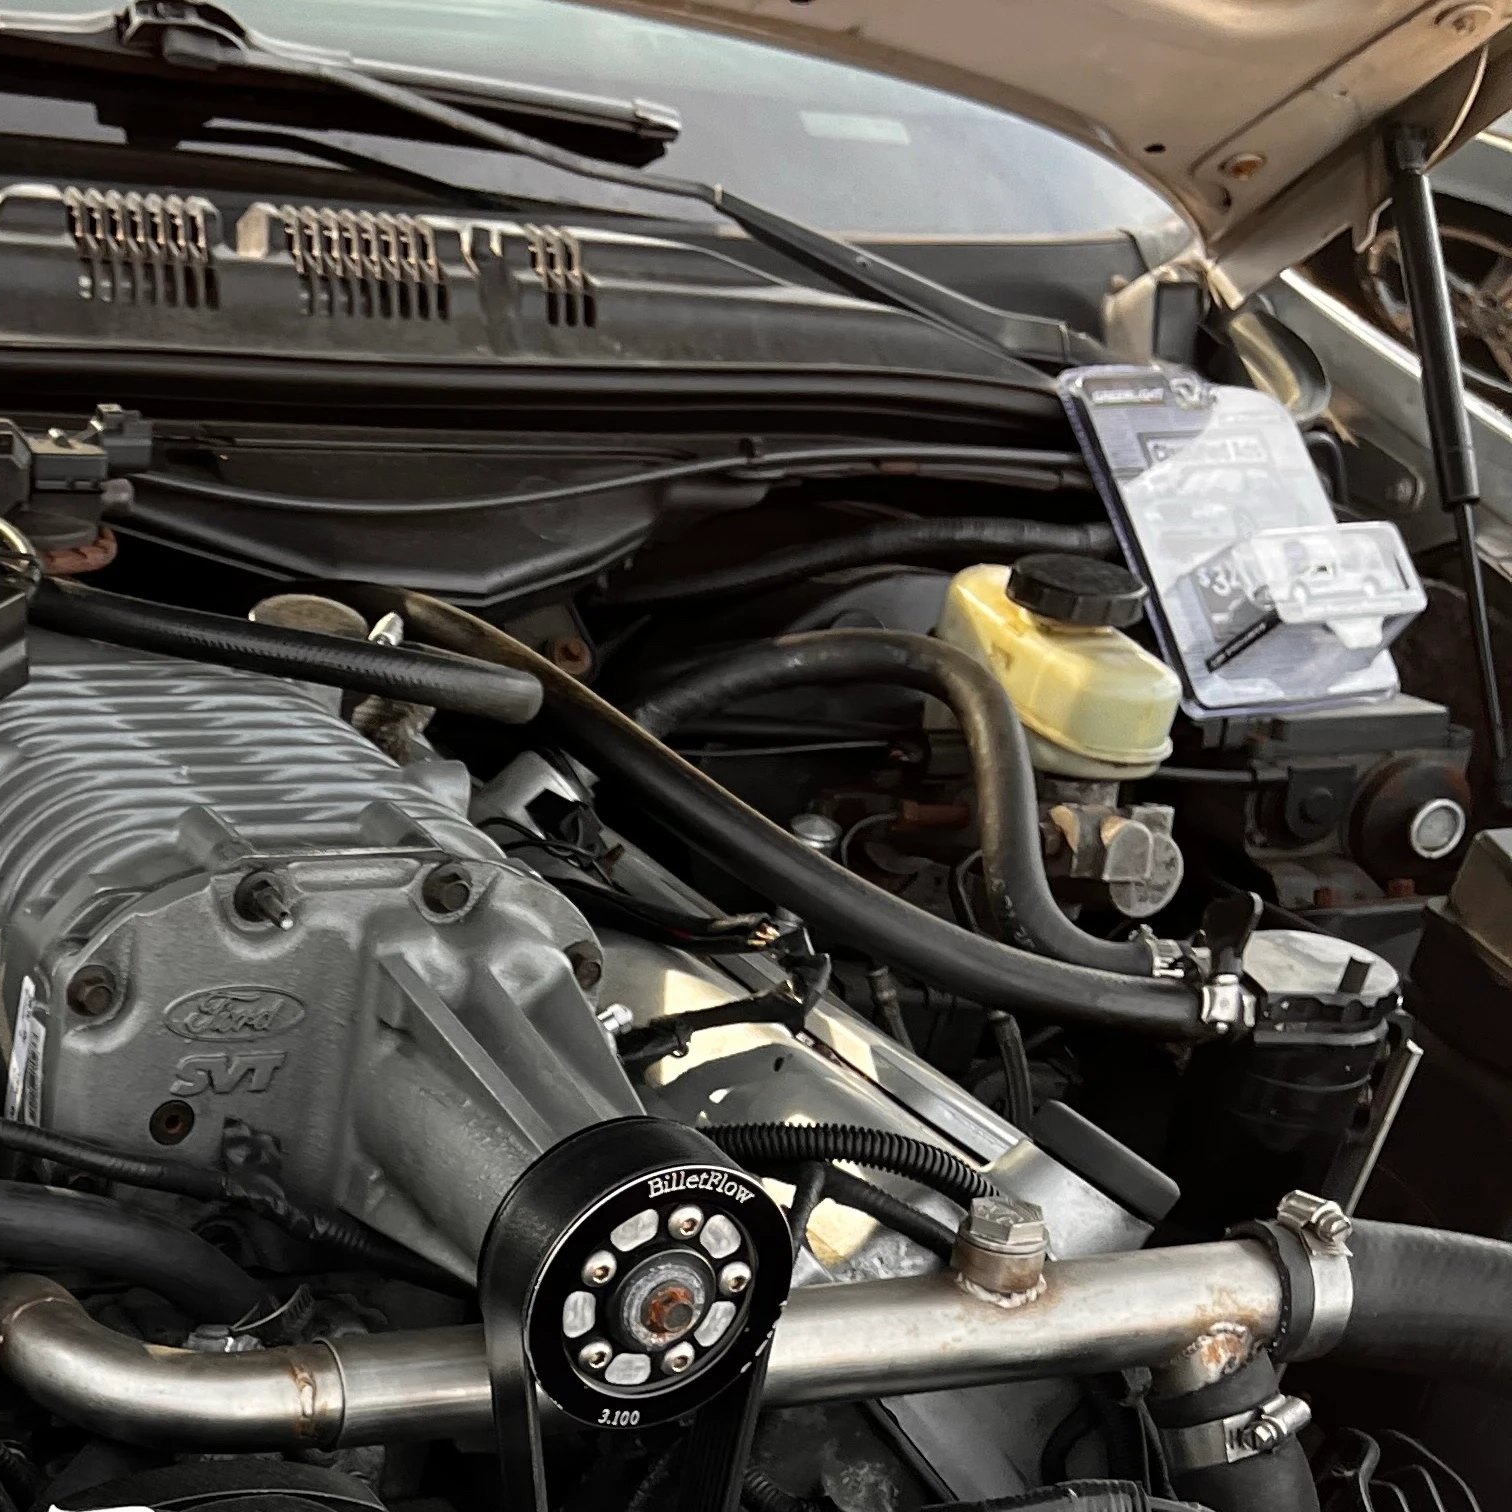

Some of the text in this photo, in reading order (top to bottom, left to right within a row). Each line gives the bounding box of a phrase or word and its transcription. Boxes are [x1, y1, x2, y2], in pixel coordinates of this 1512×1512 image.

[170, 1051, 287, 1098] SVT
[647, 1170, 756, 1204] BilletFlow
[597, 1408, 641, 1427] 3.100
